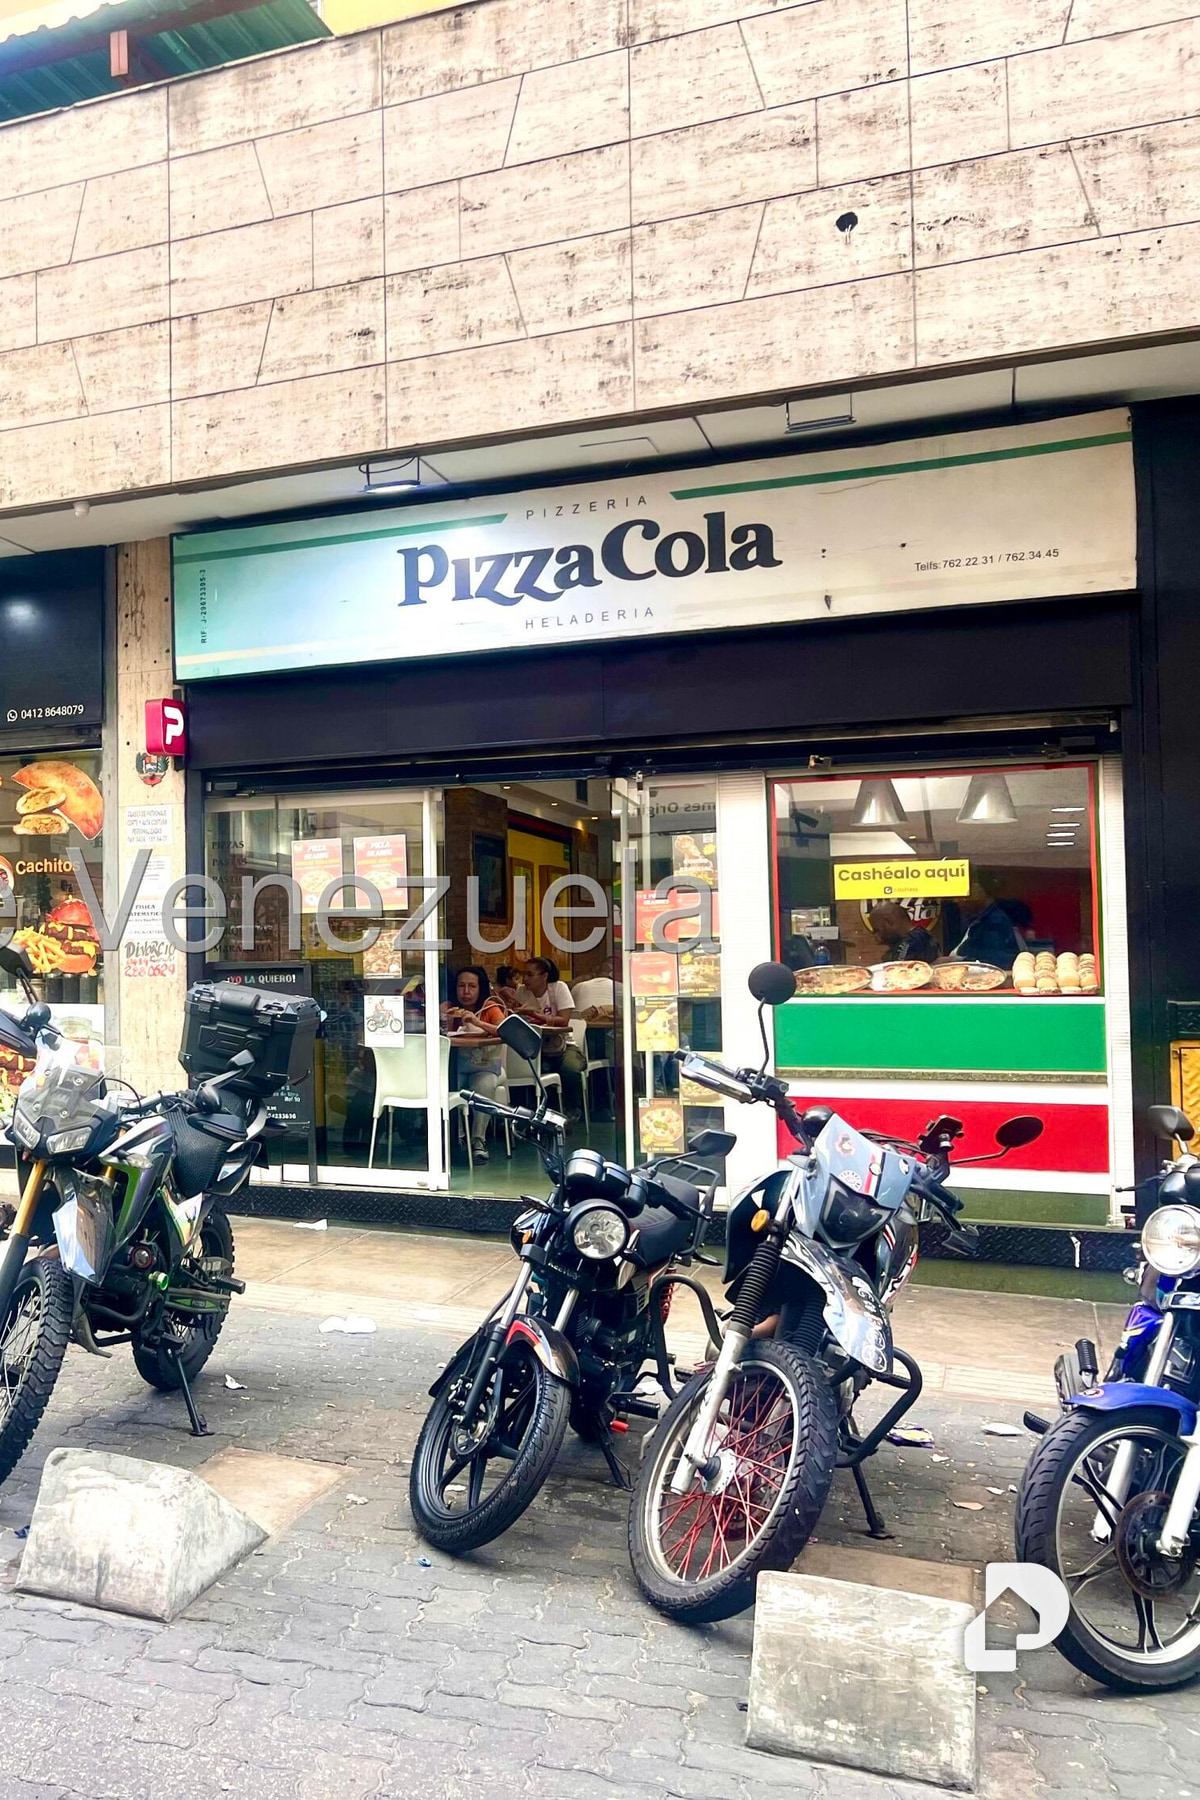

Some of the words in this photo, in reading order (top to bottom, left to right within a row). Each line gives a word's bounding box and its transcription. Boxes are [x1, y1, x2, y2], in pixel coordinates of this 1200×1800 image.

[526, 495, 648, 520] PIZZERIA
[943, 555, 994, 569] 762.22.31
[1005, 548, 1060, 562] 762.34.45
[525, 606, 655, 630] HELADERIA
[20, 708, 43, 720] 0412
[44, 704, 85, 718] 8648079
[15, 857, 81, 876] Cachitos
[838, 865, 921, 881] Cashéalo
[924, 863, 966, 882] aquí
[245, 975, 256, 984] LA
[258, 973, 297, 985] QUIERO!
